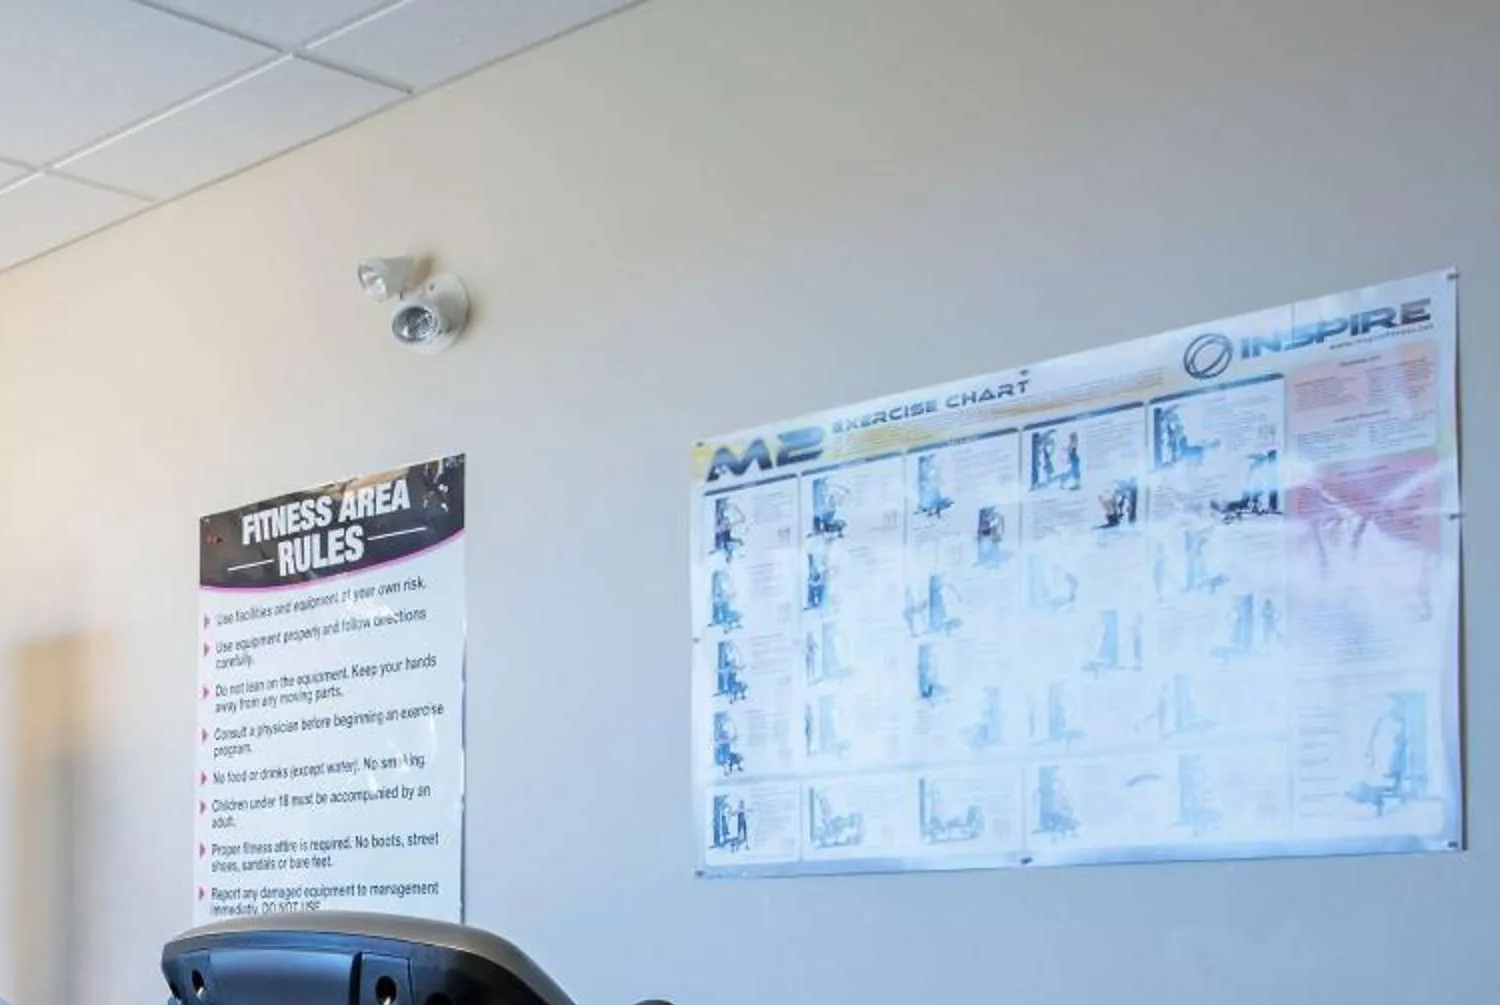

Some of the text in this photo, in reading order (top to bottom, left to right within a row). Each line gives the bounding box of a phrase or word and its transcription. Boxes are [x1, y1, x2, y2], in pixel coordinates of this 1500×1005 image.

[1241, 297, 1431, 360] INSPIRE
[705, 426, 827, 482] M2
[831, 401, 937, 434] EXERCISE
[945, 379, 1030, 410] CHART
[241, 479, 411, 546] FITNESS AREA
[277, 524, 365, 577] RULES
[274, 602, 291, 616] and
[353, 586, 375, 602] your
[377, 583, 400, 596] own
[404, 576, 426, 591] risk.
[216, 608, 426, 653] Use equipment properly and follow directions
[216, 684, 228, 697] Do
[230, 682, 244, 695] not
[246, 679, 264, 693] lean
[266, 679, 278, 690] on
[280, 674, 294, 687] the
[352, 663, 378, 678] Keep
[380, 661, 402, 677] your
[405, 652, 437, 670] hands
[216, 685, 343, 714] away from any moving parts.
[214, 726, 246, 740] Consult
[257, 720, 298, 737] physician
[301, 716, 331, 731] before
[334, 710, 383, 728] beginning
[386, 708, 398, 720] an
[400, 703, 444, 719] exercise
[213, 771, 225, 784] No
[228, 769, 246, 783] food
[260, 767, 288, 780] drinks
[290, 763, 324, 778] (except
[363, 757, 378, 770] No
[381, 752, 425, 768] smking
[212, 798, 248, 812] Children
[250, 793, 276, 809] under
[279, 793, 288, 807] 18
[291, 792, 313, 806] must
[315, 791, 328, 805] be
[401, 784, 414, 800] by
[418, 785, 430, 797] an
[211, 842, 240, 856] Proper
[243, 840, 272, 854] fitness
[274, 839, 297, 852] attire
[355, 835, 369, 848] No
[372, 833, 404, 848] boots,
[407, 832, 439, 847] street
[242, 857, 276, 871] sandals
[289, 856, 310, 869] bare
[211, 882, 439, 901] Report any damaged equipment to management
